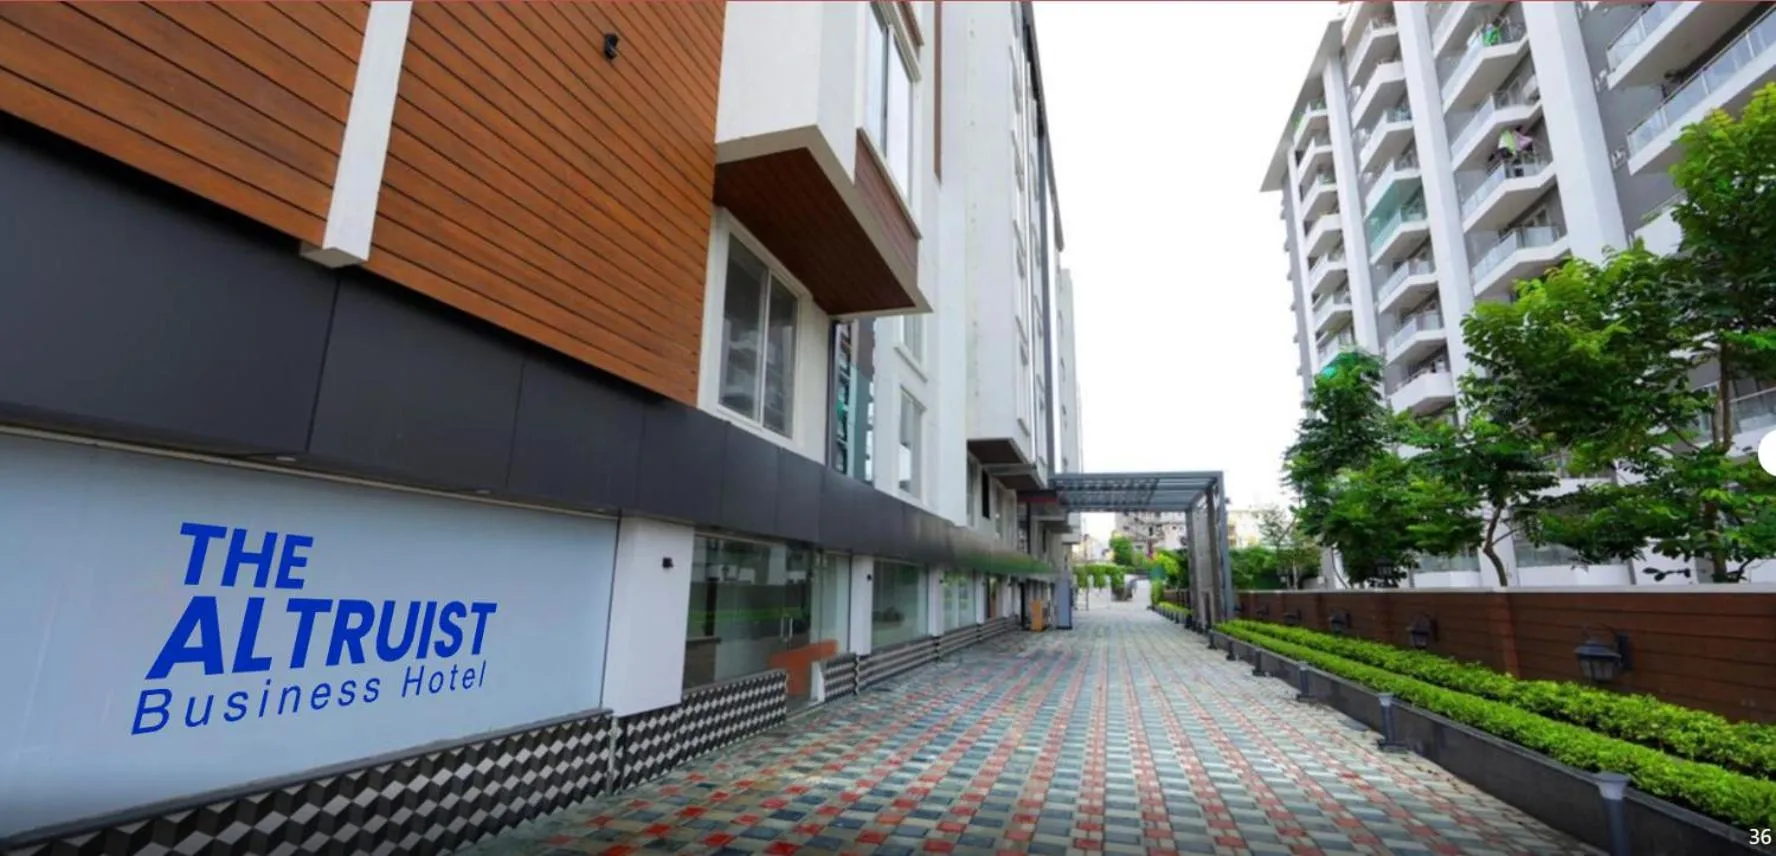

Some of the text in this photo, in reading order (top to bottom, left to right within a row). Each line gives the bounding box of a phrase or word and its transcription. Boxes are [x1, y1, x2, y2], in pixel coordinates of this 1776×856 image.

[180, 522, 313, 589] THE
[146, 596, 497, 680] ALTRUIST
[131, 660, 487, 735] Business Hotel
